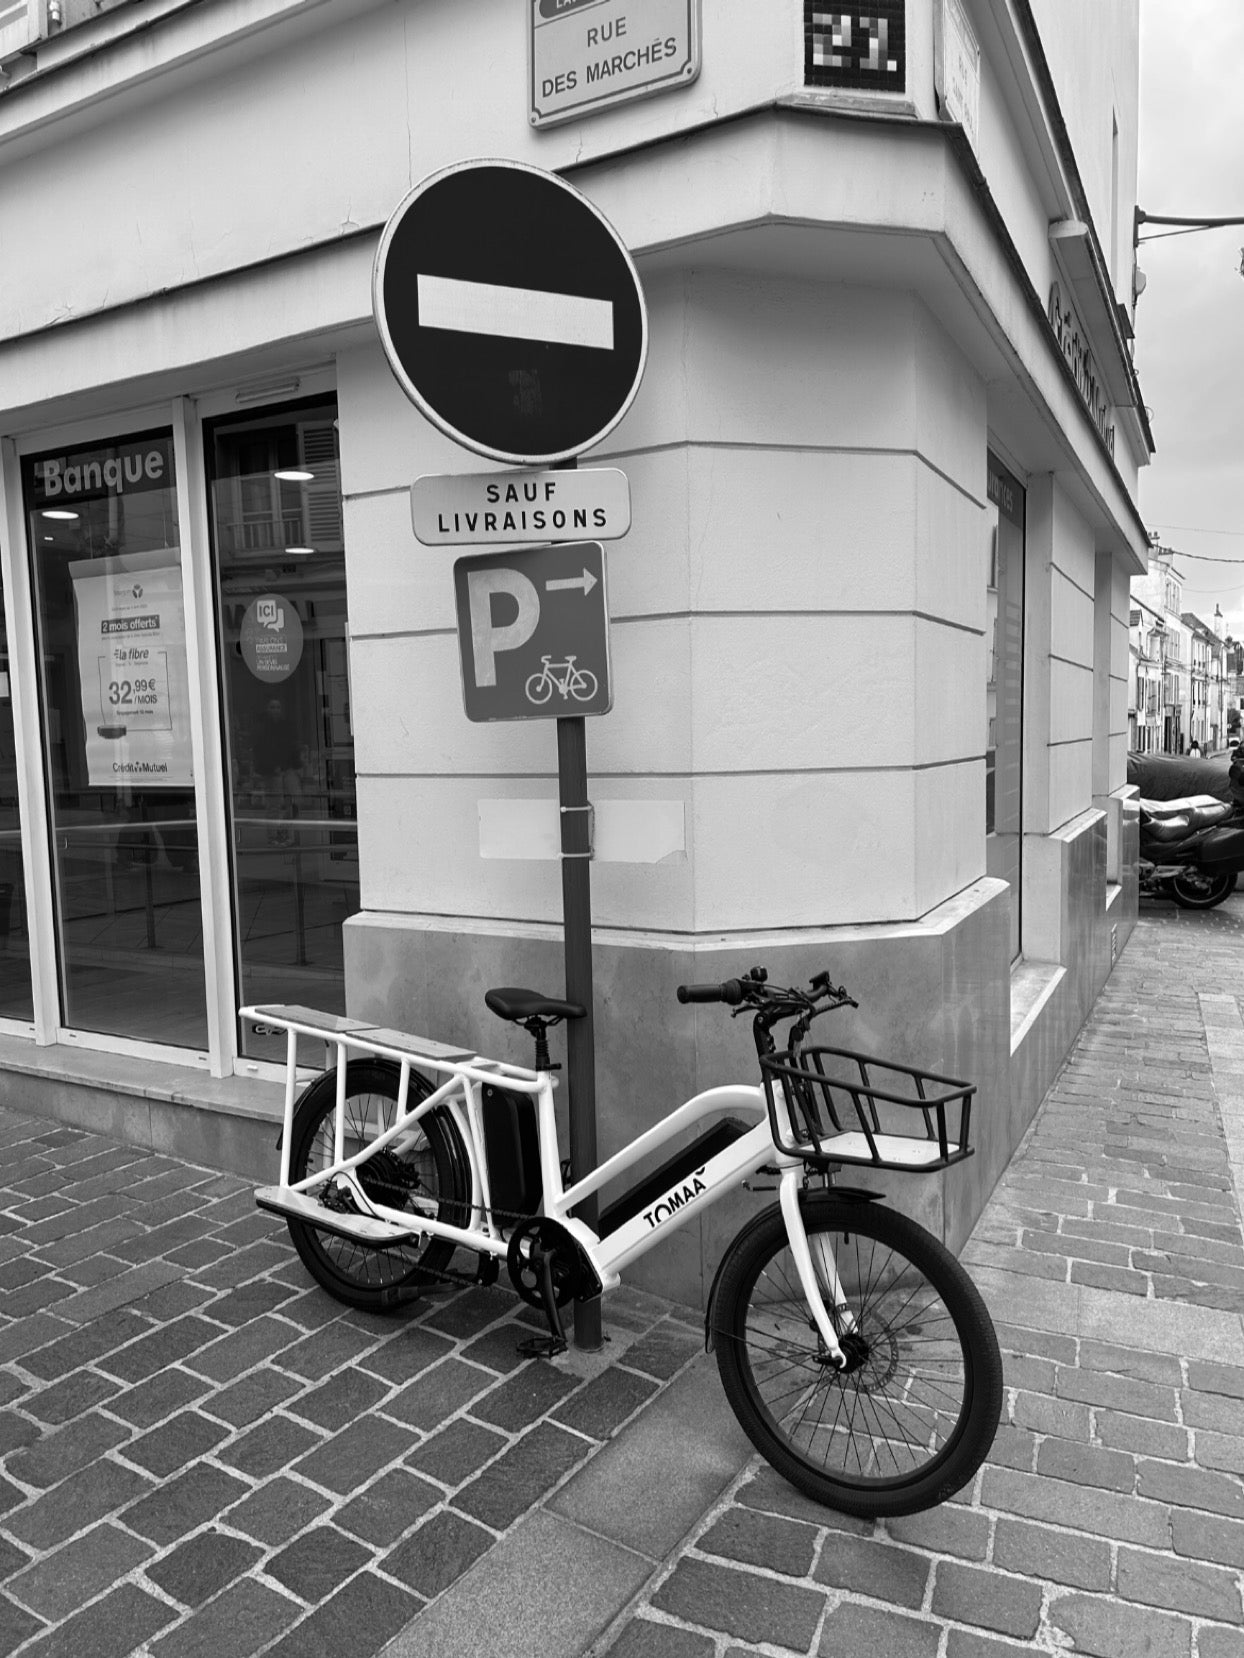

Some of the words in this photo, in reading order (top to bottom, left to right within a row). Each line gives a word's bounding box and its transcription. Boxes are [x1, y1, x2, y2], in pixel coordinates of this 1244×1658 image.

[587, 16, 627, 47] RUE
[542, 71, 577, 98] DES
[586, 37, 677, 84] MARCHÉS
[43, 451, 164, 496] Banque
[486, 482, 556, 503] SAUF
[438, 508, 607, 532] LIVRAISONS
[259, 605, 274, 617] ICI
[102, 622, 109, 632] 2
[109, 620, 128, 631] mois
[467, 568, 541, 688] P
[119, 649, 127, 660] la
[129, 648, 149, 660] fibre
[142, 762, 168, 773] Mutuel
